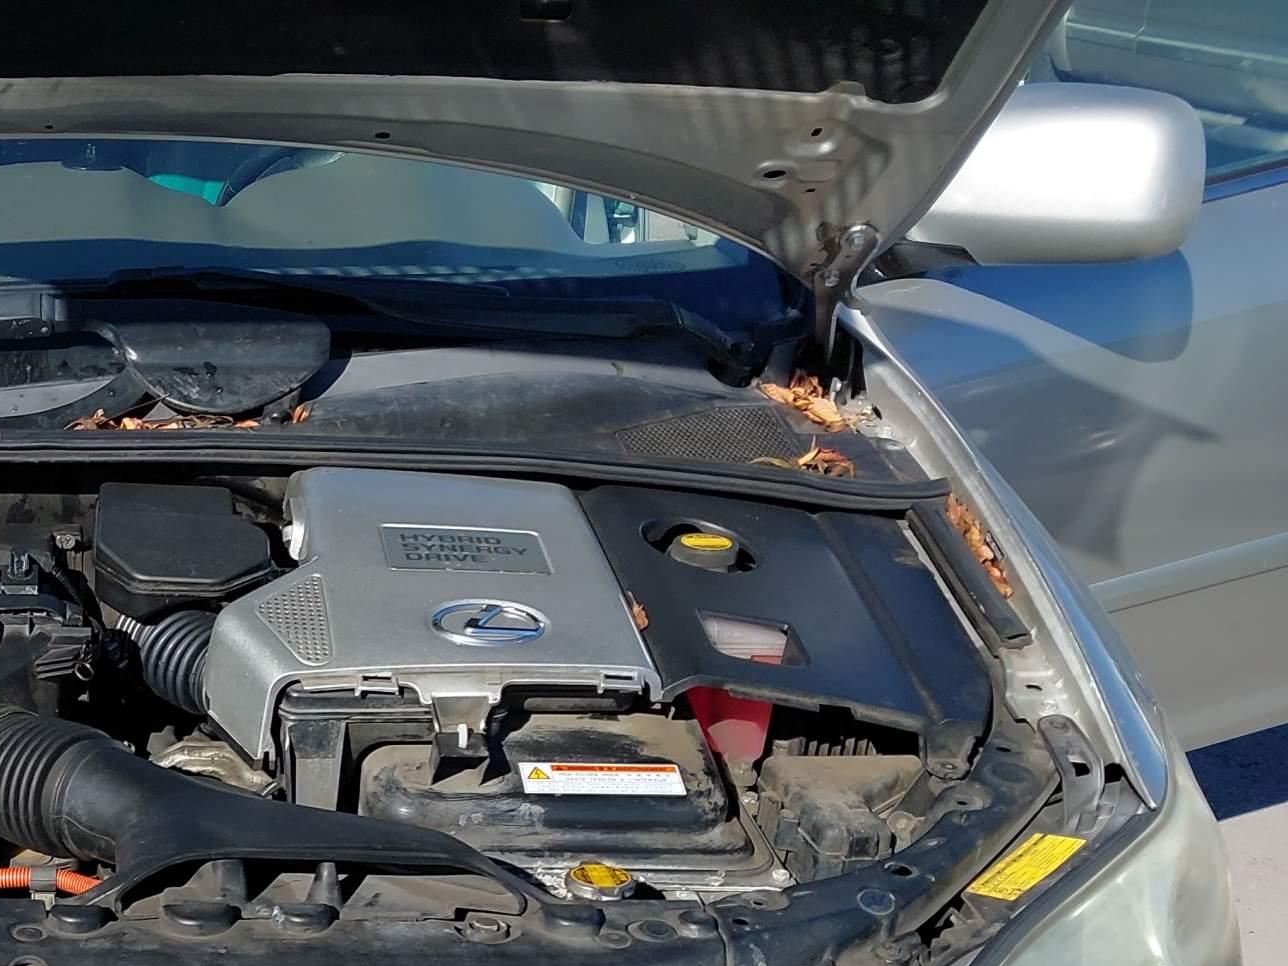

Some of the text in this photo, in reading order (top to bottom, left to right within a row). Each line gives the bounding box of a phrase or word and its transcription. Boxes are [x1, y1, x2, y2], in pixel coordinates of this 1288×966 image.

[399, 533, 502, 545] HYBRID
[402, 542, 528, 556] SYNERGY
[404, 552, 487, 563] DRIVE
